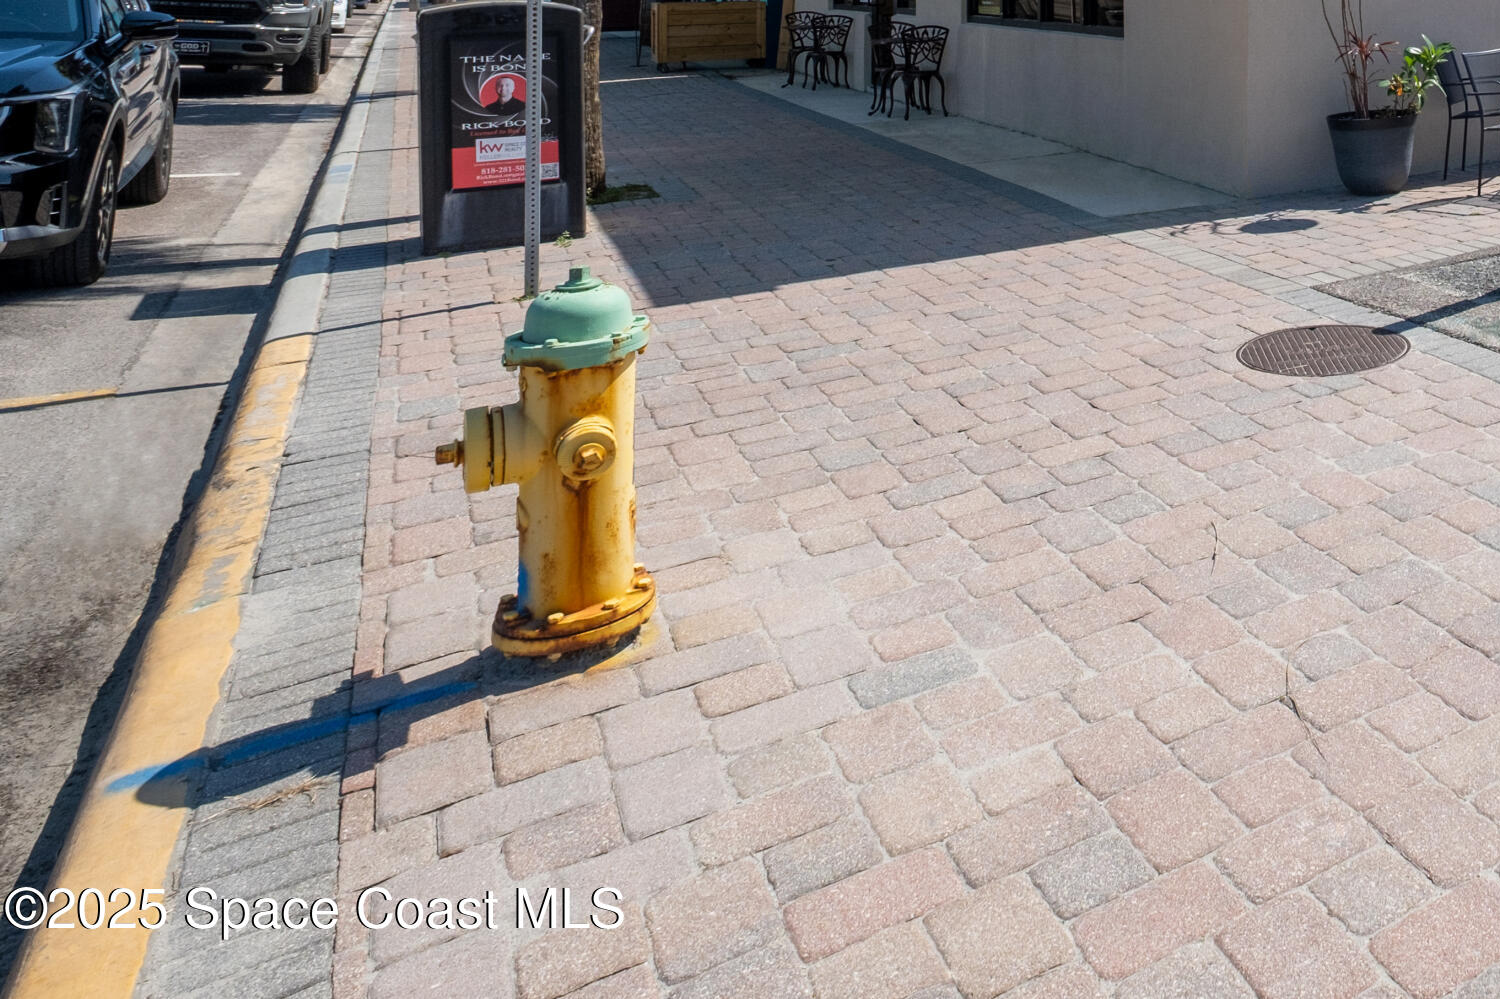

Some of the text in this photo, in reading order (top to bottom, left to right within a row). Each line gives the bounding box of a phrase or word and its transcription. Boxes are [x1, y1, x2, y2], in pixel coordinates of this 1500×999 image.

[460, 53, 551, 63] THE NAE
[472, 64, 526, 73] IS BON
[462, 117, 551, 130] RICK BOD
[480, 141, 503, 153] kw
